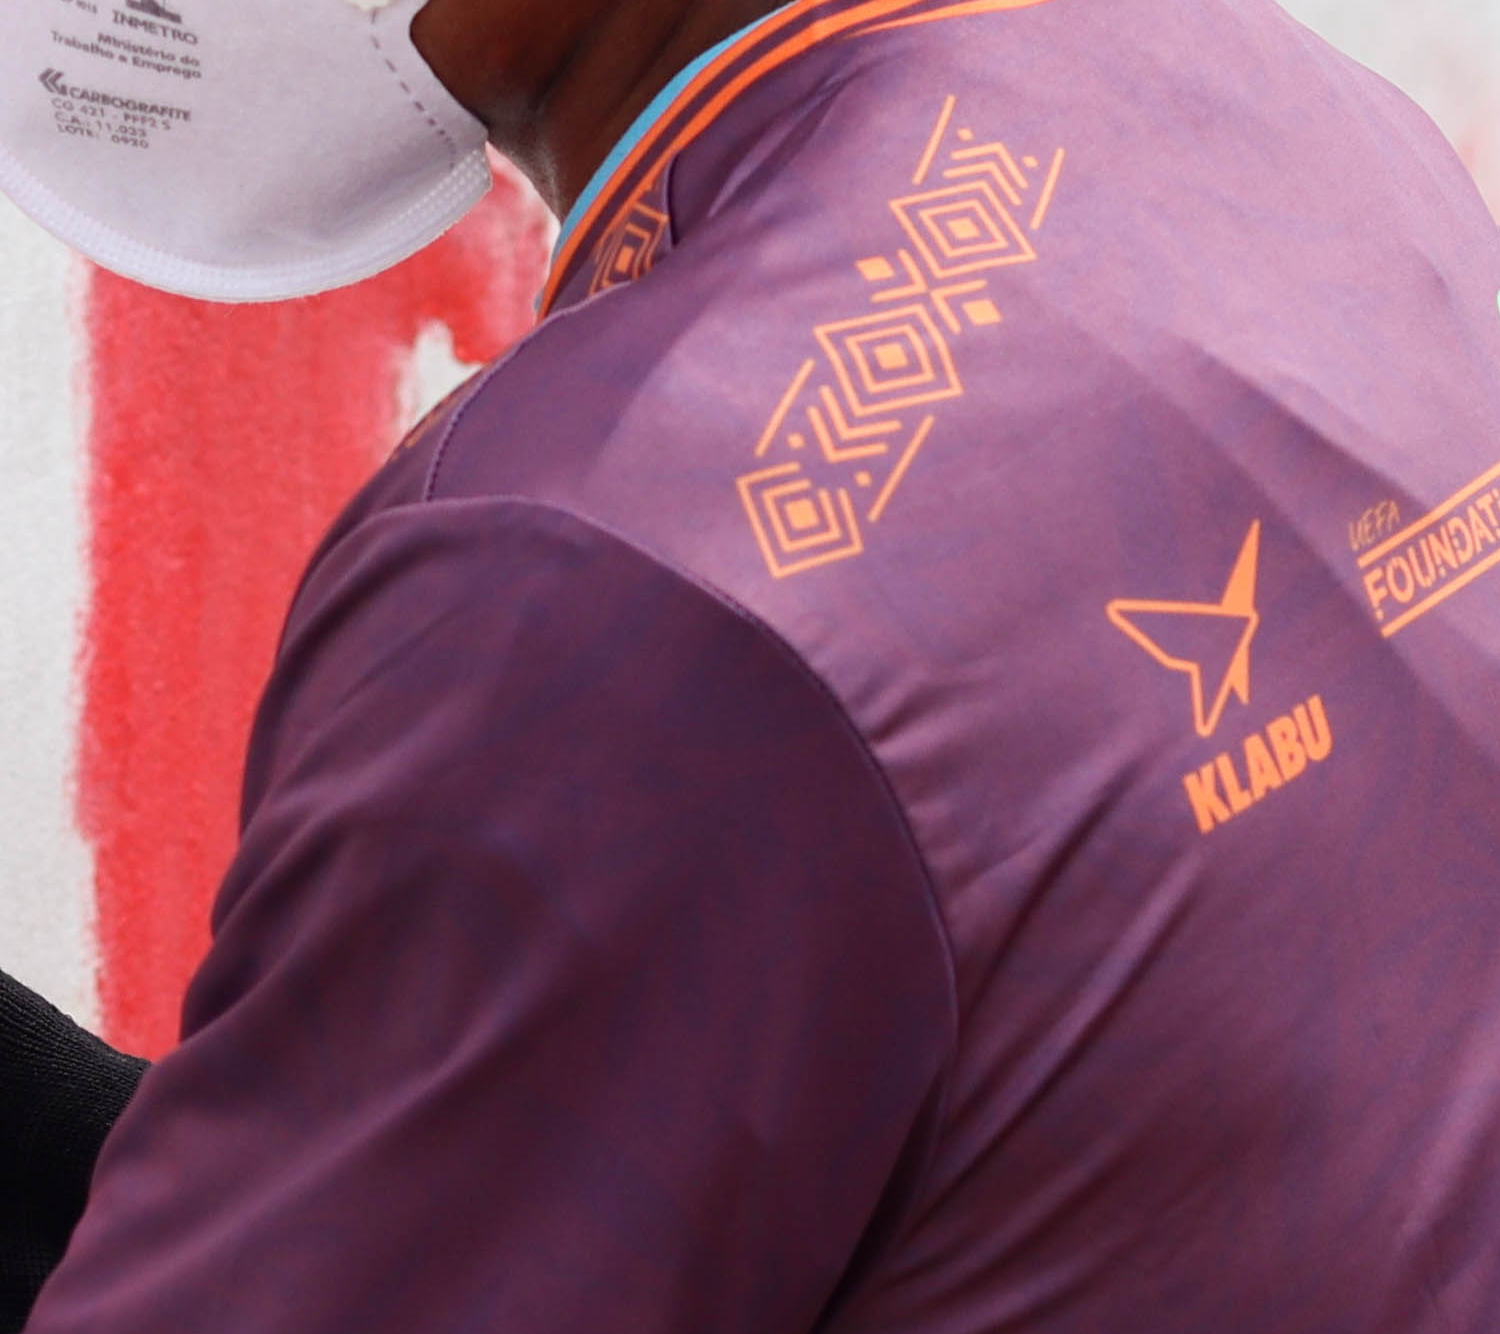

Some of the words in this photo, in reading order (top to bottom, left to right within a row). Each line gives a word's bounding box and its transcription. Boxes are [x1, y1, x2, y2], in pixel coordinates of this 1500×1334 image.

[97, 32, 176, 62] Ministério
[112, 10, 199, 45] INMETRO
[50, 30, 115, 60] Trabalho
[132, 57, 202, 80] Emprego
[70, 86, 192, 122] CARBOGRAFITE
[1350, 500, 1400, 551] UEFA
[1182, 694, 1334, 834] KLABU
